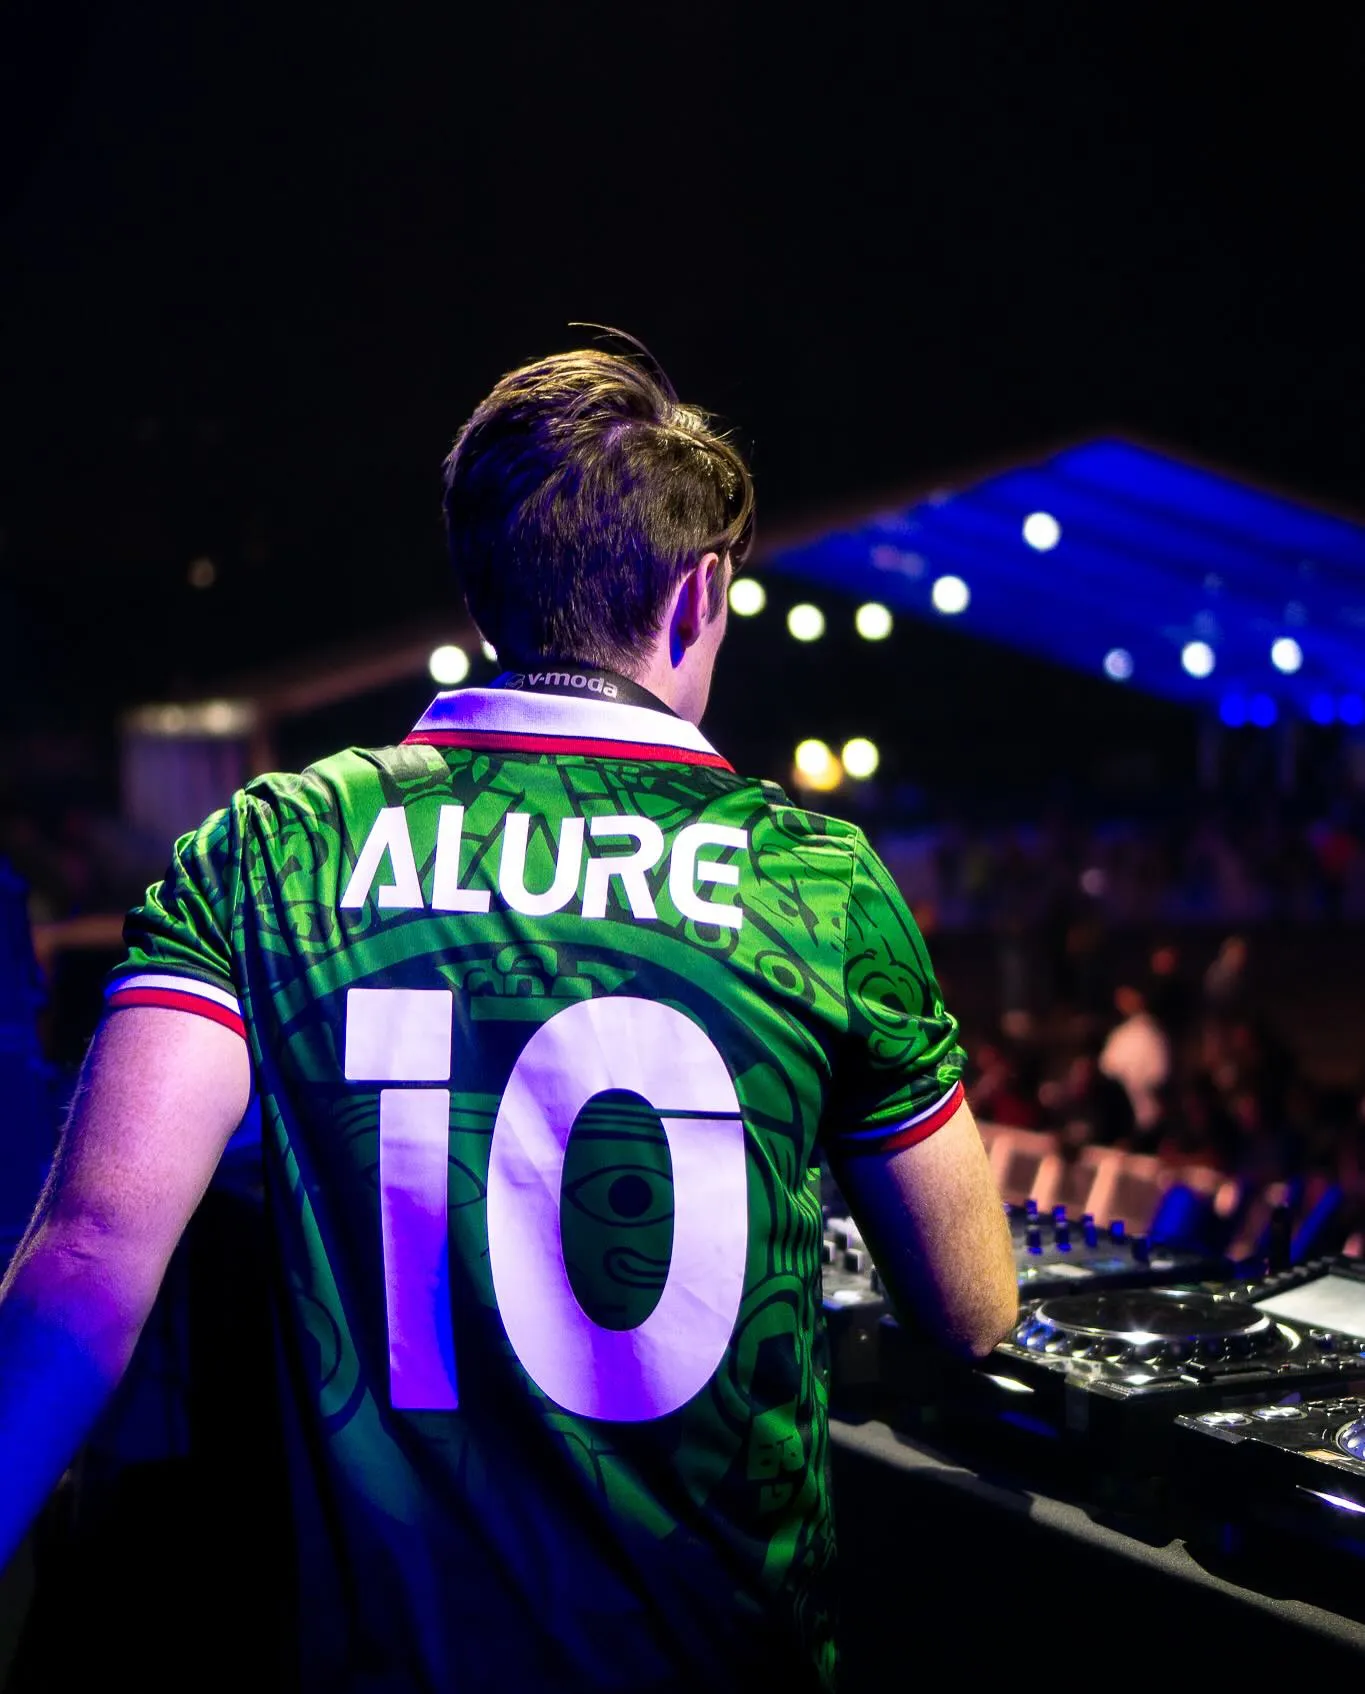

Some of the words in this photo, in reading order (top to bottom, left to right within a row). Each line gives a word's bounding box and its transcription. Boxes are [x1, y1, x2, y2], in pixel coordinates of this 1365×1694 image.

[527, 671, 618, 699] v-moda
[340, 804, 748, 929] ALURE
[344, 987, 748, 1422] 10
